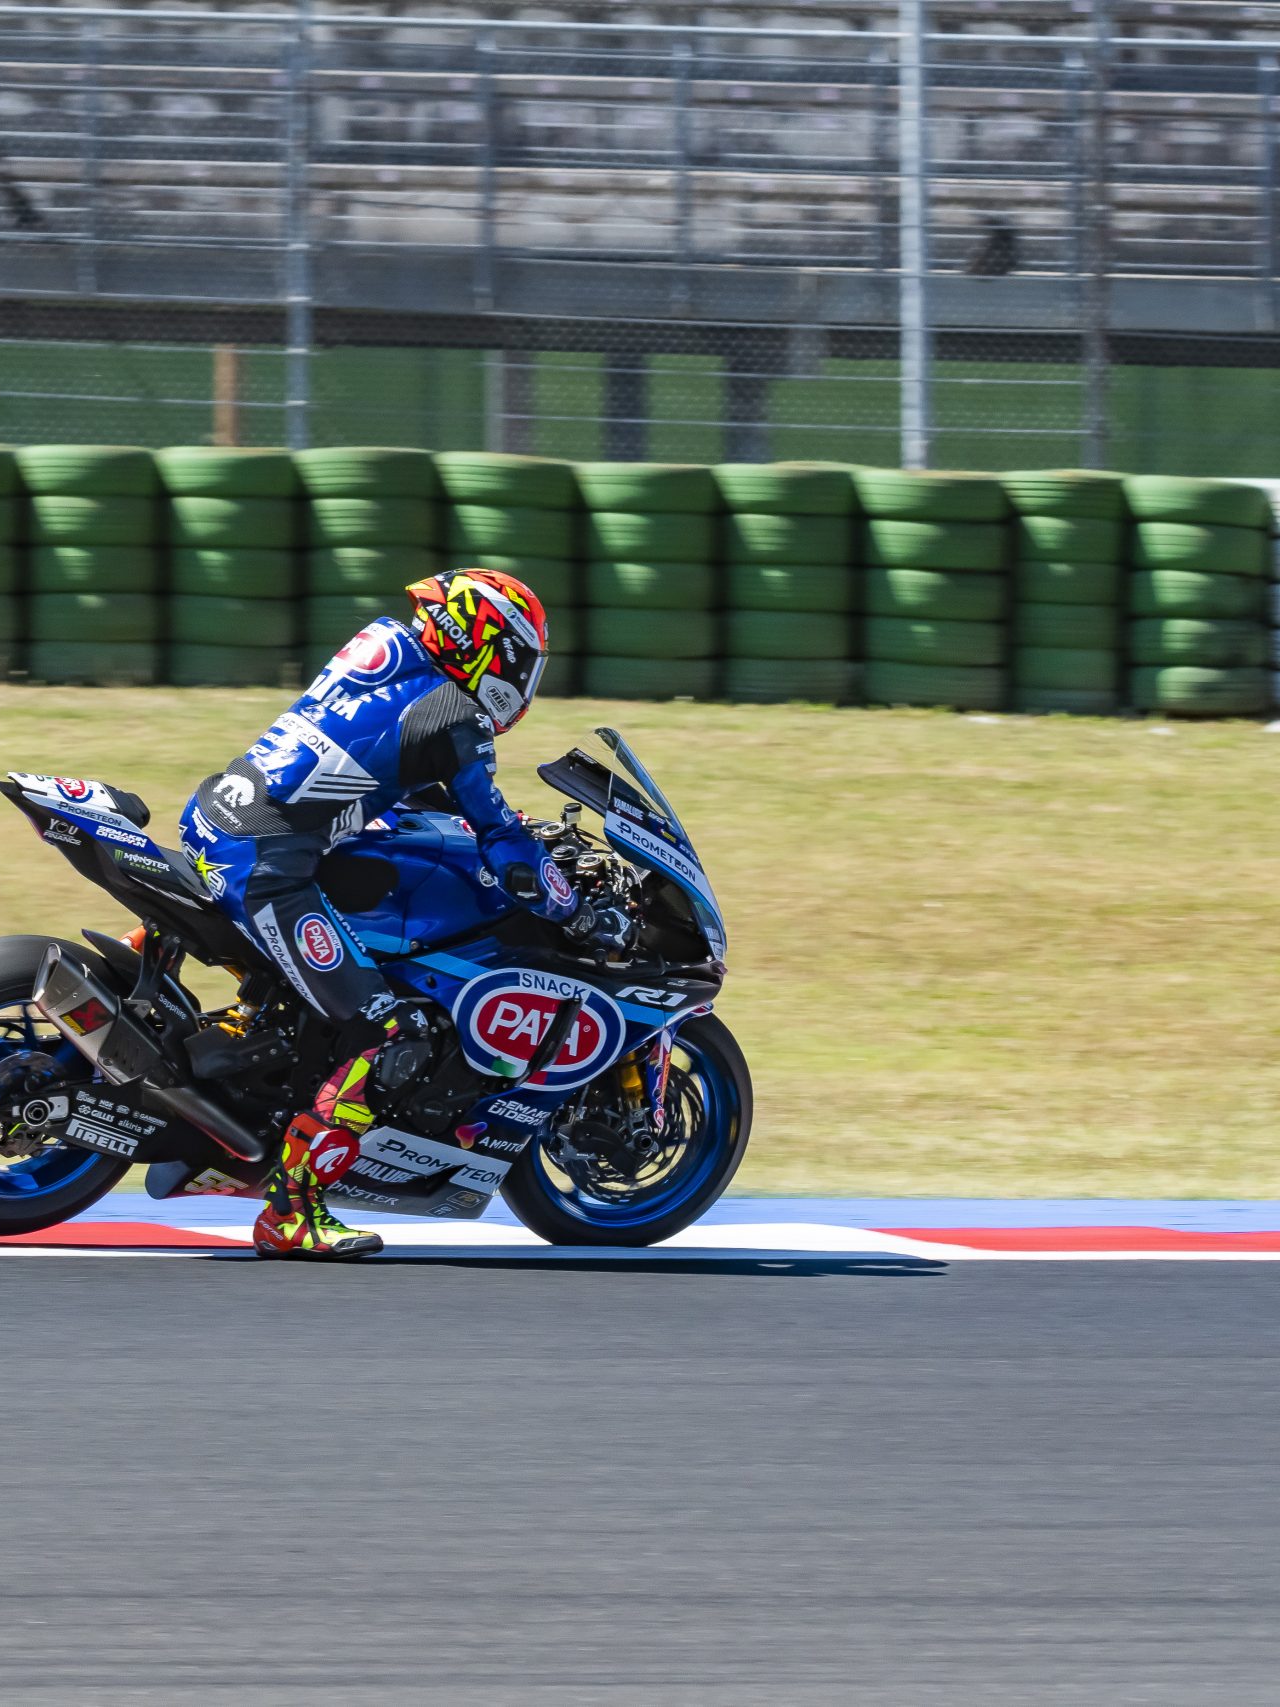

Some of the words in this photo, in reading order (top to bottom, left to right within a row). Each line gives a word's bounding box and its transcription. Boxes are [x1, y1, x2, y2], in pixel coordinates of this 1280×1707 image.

[425, 603, 473, 650] AIROH
[49, 818, 80, 835] YOU
[57, 801, 122, 826] PROMETEON
[124, 852, 170, 871] MONSTER
[616, 821, 696, 881] PROMETEON
[547, 867, 567, 895] PATA
[307, 924, 331, 960] PATA
[263, 923, 311, 1000] PROMETEON
[522, 973, 587, 1001] SNACK
[158, 994, 188, 1020] Sapphire
[66, 1119, 139, 1157] PIRELLI
[376, 1138, 505, 1185] PROMTEON
